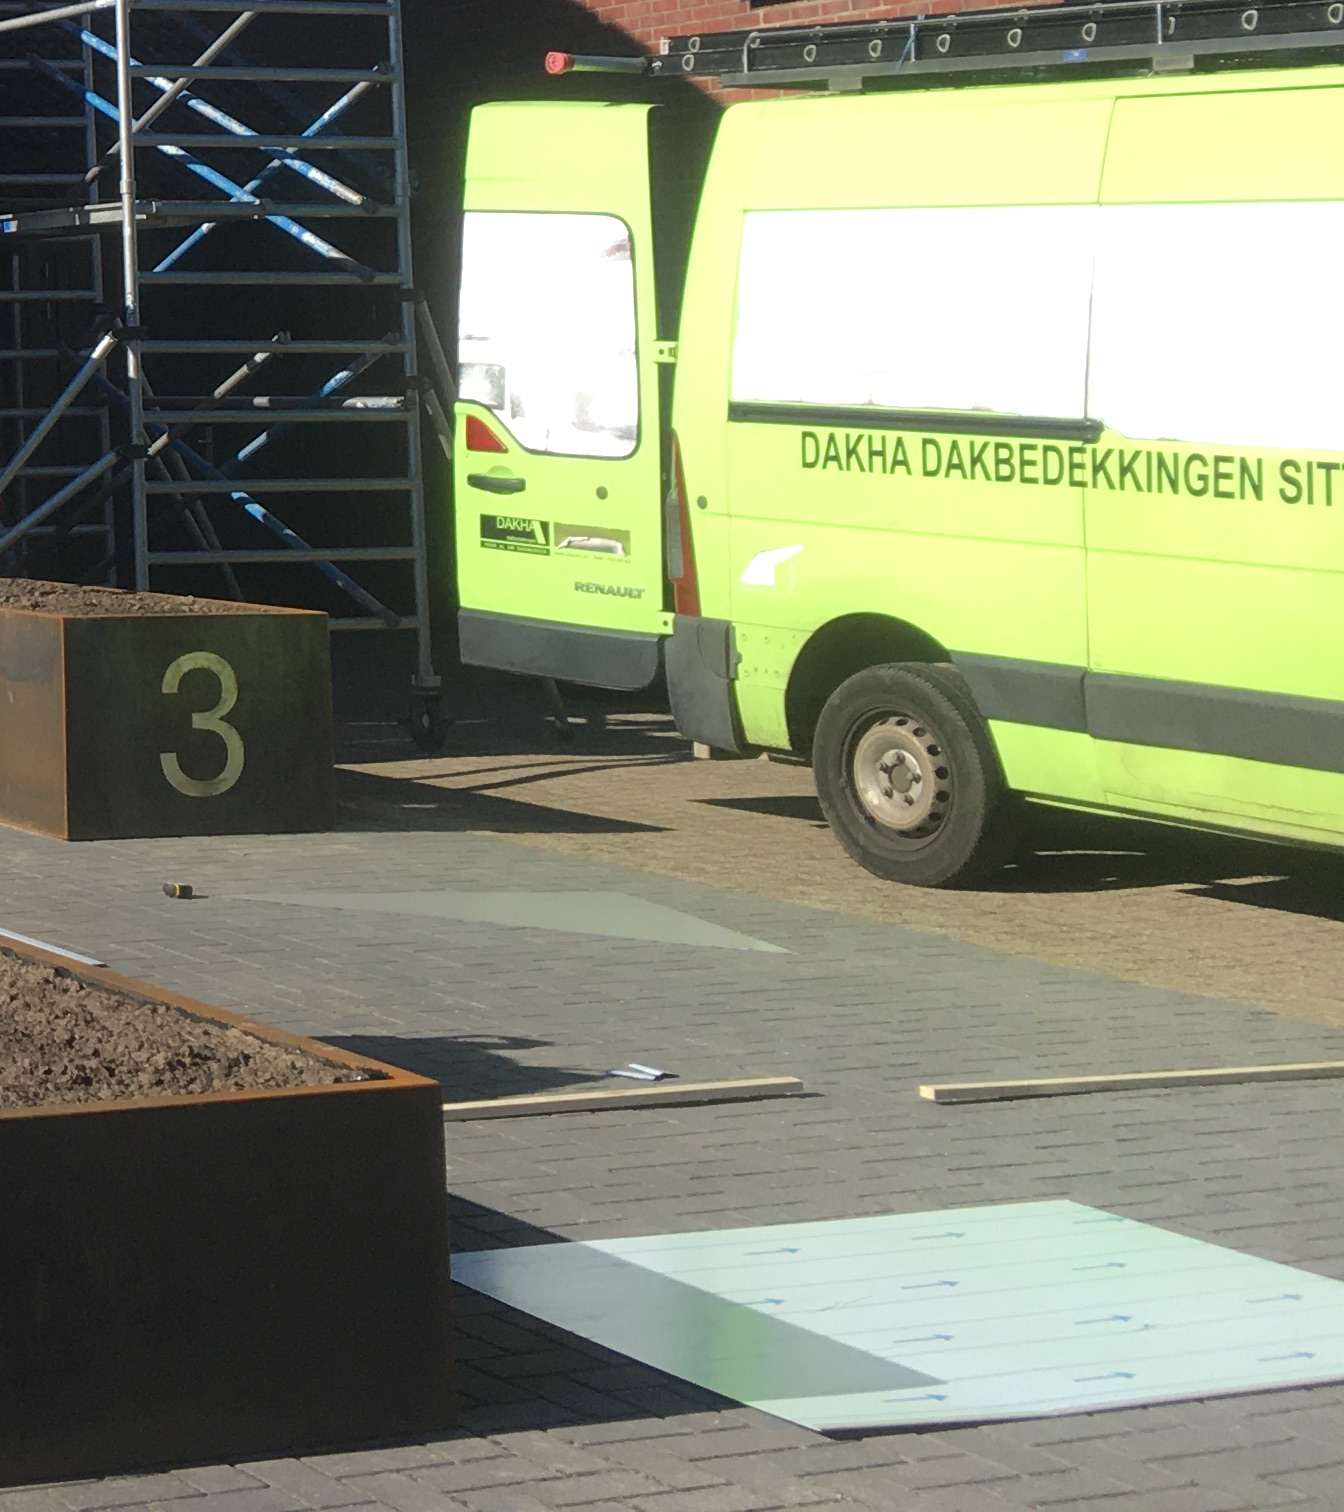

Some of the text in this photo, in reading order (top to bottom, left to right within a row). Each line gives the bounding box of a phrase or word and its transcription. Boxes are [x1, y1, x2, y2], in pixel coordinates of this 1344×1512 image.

[801, 430, 1344, 507] DAKHA DAKBEDEKKINGEN SIT
[496, 516, 542, 535] DAKHA
[574, 580, 645, 599] RENAULT
[160, 651, 245, 798] 3
